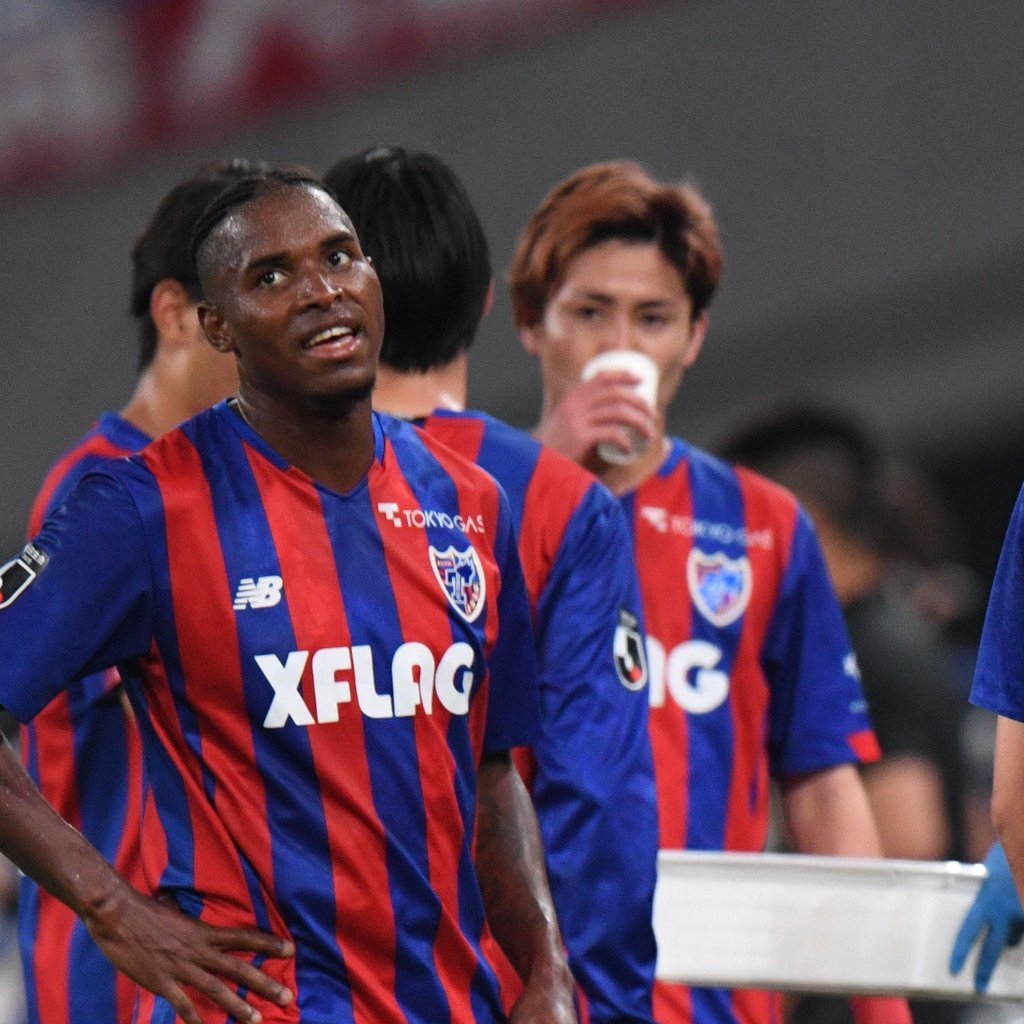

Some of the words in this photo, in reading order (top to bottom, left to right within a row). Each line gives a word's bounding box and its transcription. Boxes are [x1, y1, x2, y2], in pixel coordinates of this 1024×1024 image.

[402, 509, 454, 530] TOKYO
[453, 514, 485, 533] GAS
[254, 641, 475, 728] XFLAG
